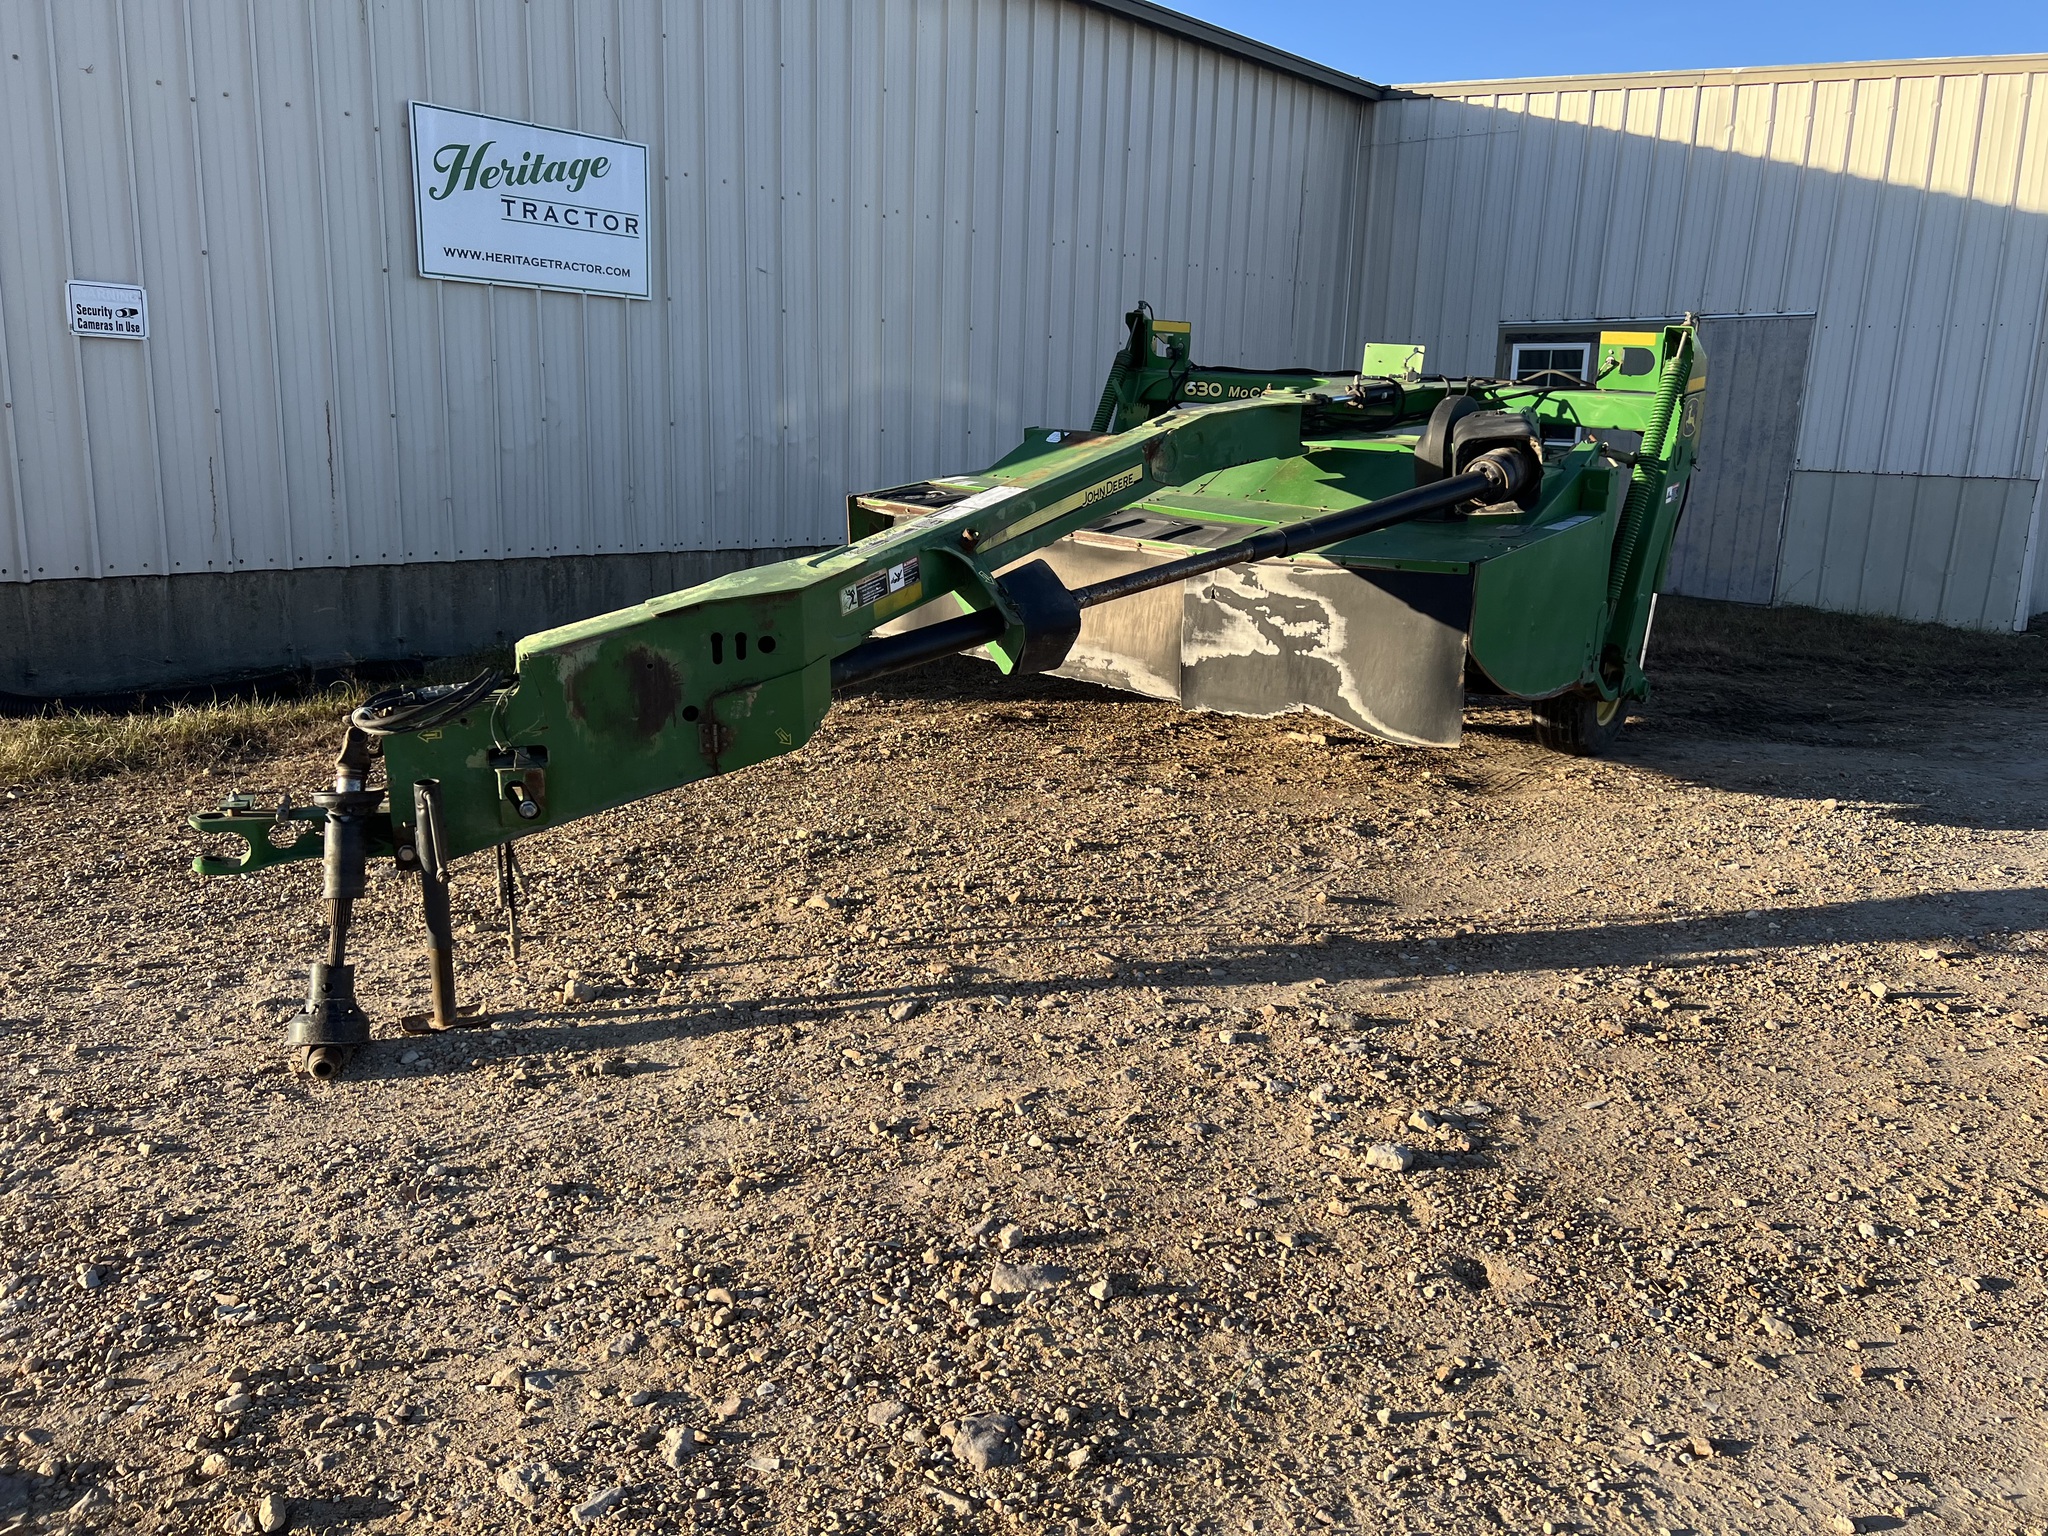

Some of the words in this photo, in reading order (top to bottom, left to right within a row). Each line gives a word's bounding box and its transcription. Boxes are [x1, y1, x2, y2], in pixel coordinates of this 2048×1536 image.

[428, 141, 612, 200] Heritage
[500, 198, 639, 235] TRACTOR
[443, 246, 631, 277] WWW.HERITAGETRACTOR.COM
[76, 303, 113, 320] Security
[77, 317, 114, 331] Cameras
[115, 320, 124, 332] In
[126, 321, 140, 333] Use
[1184, 381, 1223, 397] 630
[1082, 485, 1106, 507] JOHN
[1106, 473, 1134, 495] DEERE
